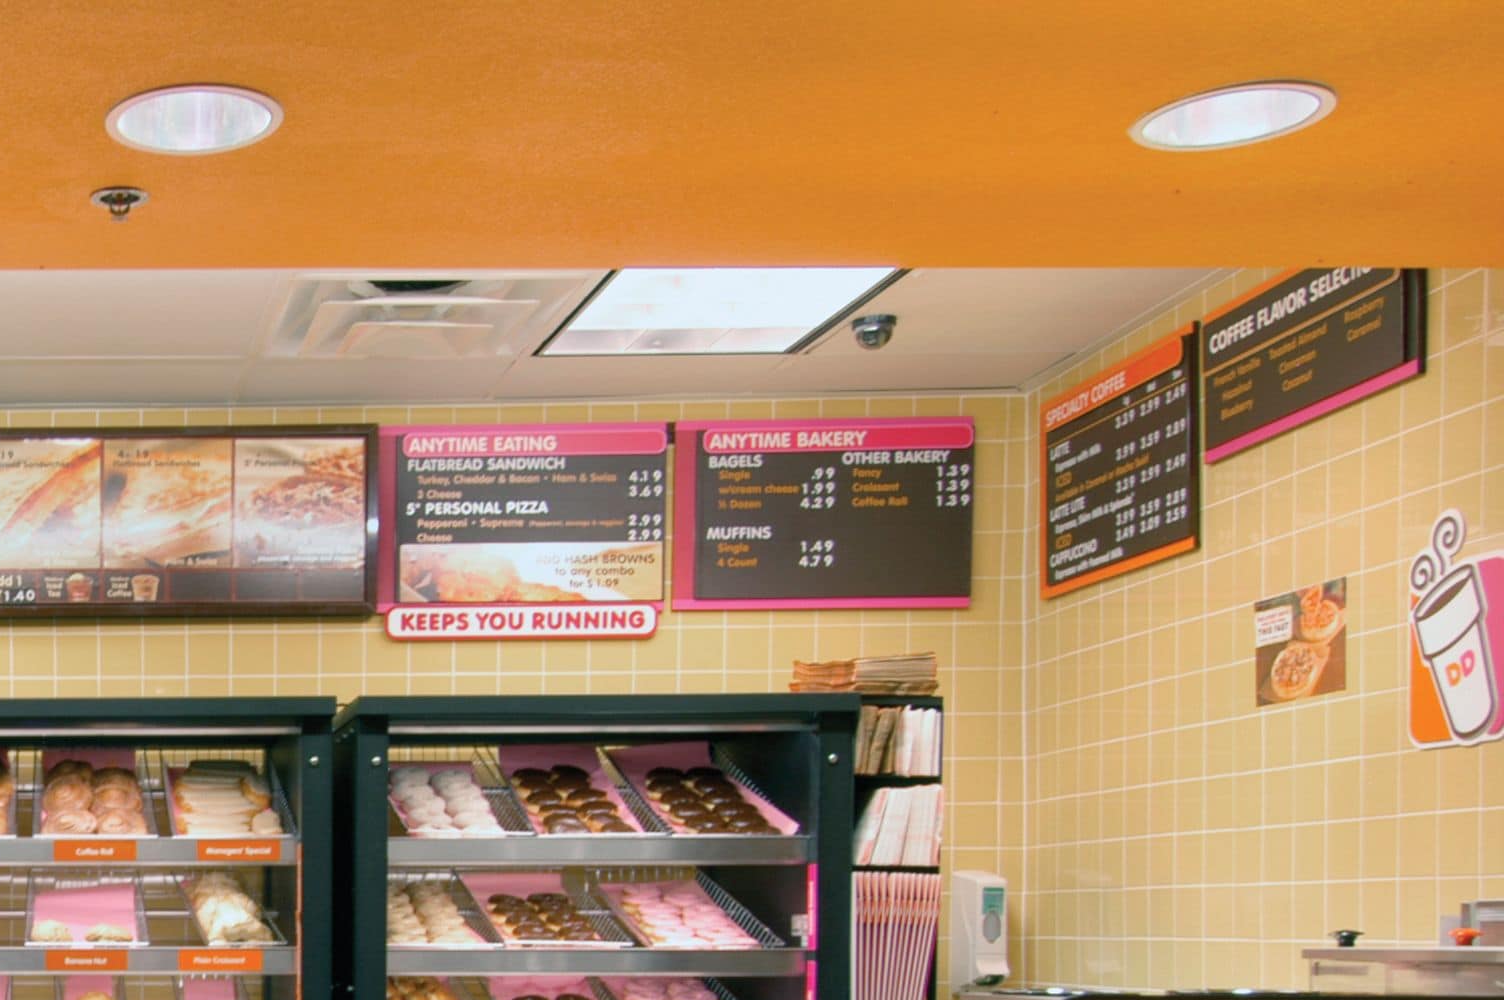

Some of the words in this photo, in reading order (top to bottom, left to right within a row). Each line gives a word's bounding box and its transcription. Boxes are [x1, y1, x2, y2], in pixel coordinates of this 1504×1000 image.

[1209, 312, 1254, 354] COFFEE
[1256, 286, 1307, 330] FLAVOR
[1091, 371, 1126, 402] COFFEE
[409, 437, 487, 452] ANYTIME
[493, 436, 557, 451] EATING
[709, 433, 790, 449] ANYTIME
[797, 431, 867, 447] BAKERY
[709, 455, 763, 468] BAGELS
[842, 452, 891, 464] OTHER
[895, 451, 950, 463] BAKERY
[408, 459, 483, 471] FLATBREAD
[487, 458, 565, 469] SANDWICH
[629, 471, 662, 482] 4.19
[719, 470, 751, 481] Single
[812, 468, 835, 480] .99
[853, 469, 881, 478] Fancy
[937, 464, 970, 477] 1.39
[629, 486, 662, 497] 3.69
[802, 483, 835, 494] 1.99
[937, 480, 970, 492] 1.39
[800, 497, 835, 509] 4.29
[852, 497, 885, 507] Coffee
[936, 495, 970, 507] 1.39
[425, 503, 501, 515] PERSONAL
[506, 502, 548, 514] PIZZA
[629, 515, 662, 526] 2.99
[628, 529, 662, 541] 2.99
[707, 527, 772, 539] MUFFINS
[717, 543, 749, 553] Single
[800, 541, 834, 552] 1.49
[565, 553, 597, 564] HASH
[602, 553, 655, 564] BROWNS
[799, 555, 834, 567] 4.79
[571, 567, 591, 577] any
[595, 566, 635, 575] combo
[3, 590, 35, 602] 1.40
[401, 613, 469, 630] KEEPS
[475, 612, 523, 630] YOU
[532, 611, 644, 629] RUNNING
[1446, 649, 1475, 687] DD
